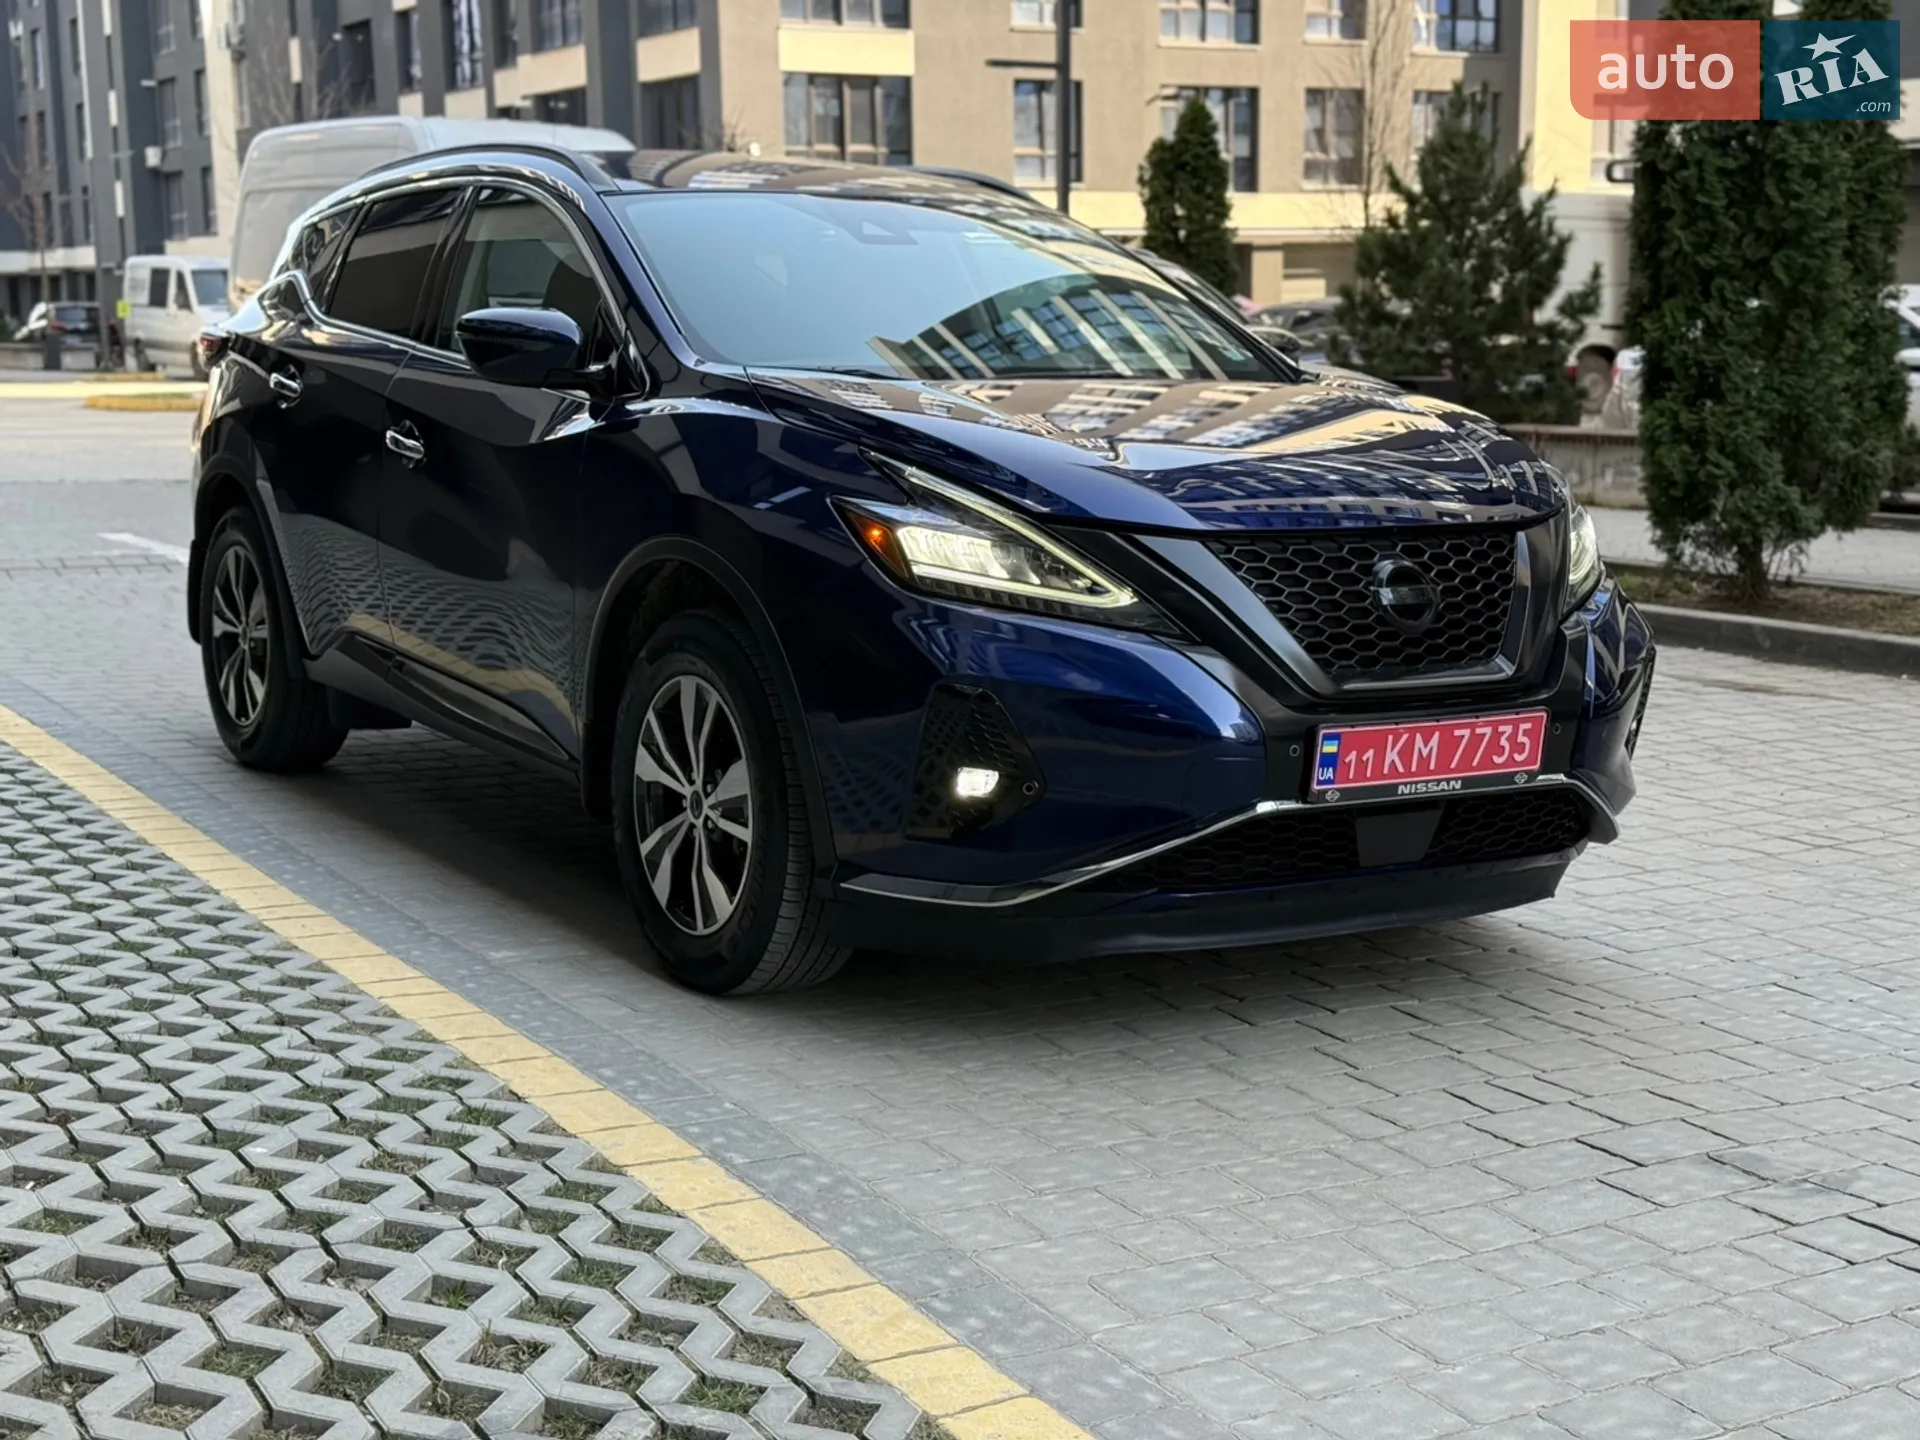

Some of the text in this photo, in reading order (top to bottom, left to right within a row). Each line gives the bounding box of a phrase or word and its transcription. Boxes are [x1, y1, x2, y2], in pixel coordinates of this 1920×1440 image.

[1344, 723, 1533, 780] 11 KM 7735
[1318, 768, 1334, 781] UA
[1397, 780, 1462, 795] NISSAN
